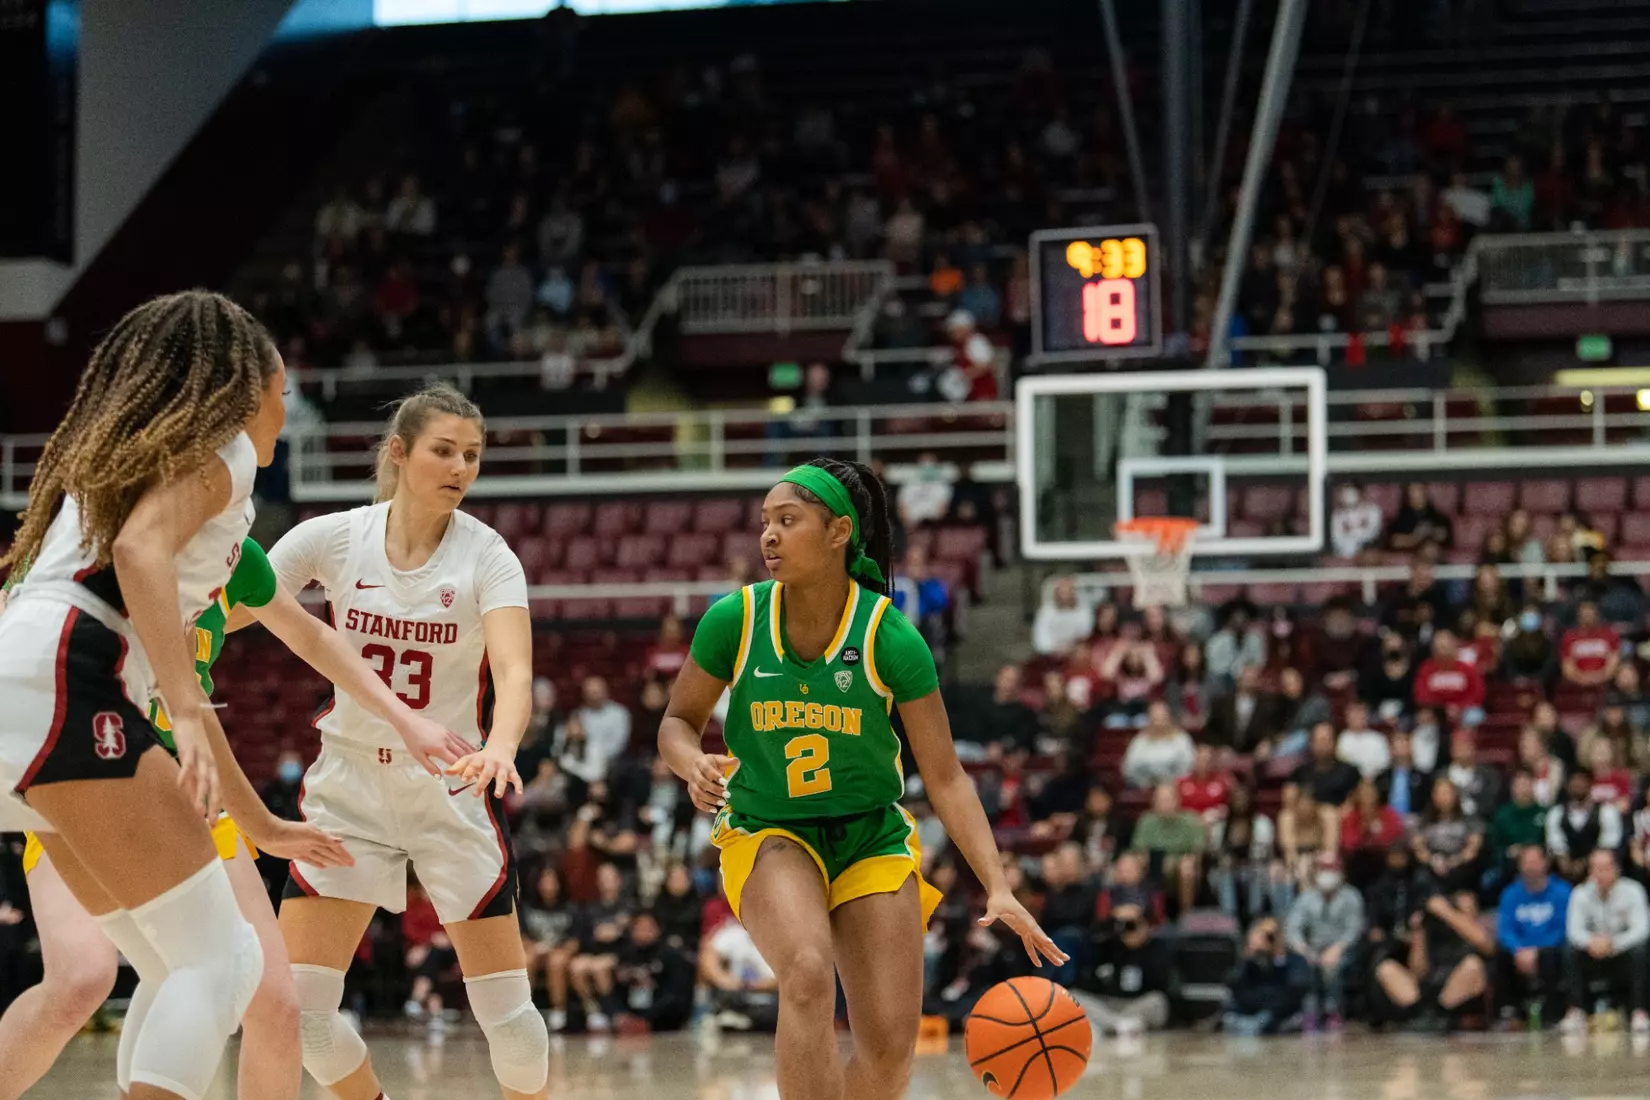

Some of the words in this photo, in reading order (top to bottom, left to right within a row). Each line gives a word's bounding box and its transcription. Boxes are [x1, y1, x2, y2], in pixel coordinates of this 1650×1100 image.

[1082, 278, 1136, 345] 18
[345, 608, 458, 645] STANFORD
[361, 643, 433, 710] 33
[92, 711, 126, 759] S
[750, 700, 862, 736] OREGON
[784, 733, 832, 798] 2
